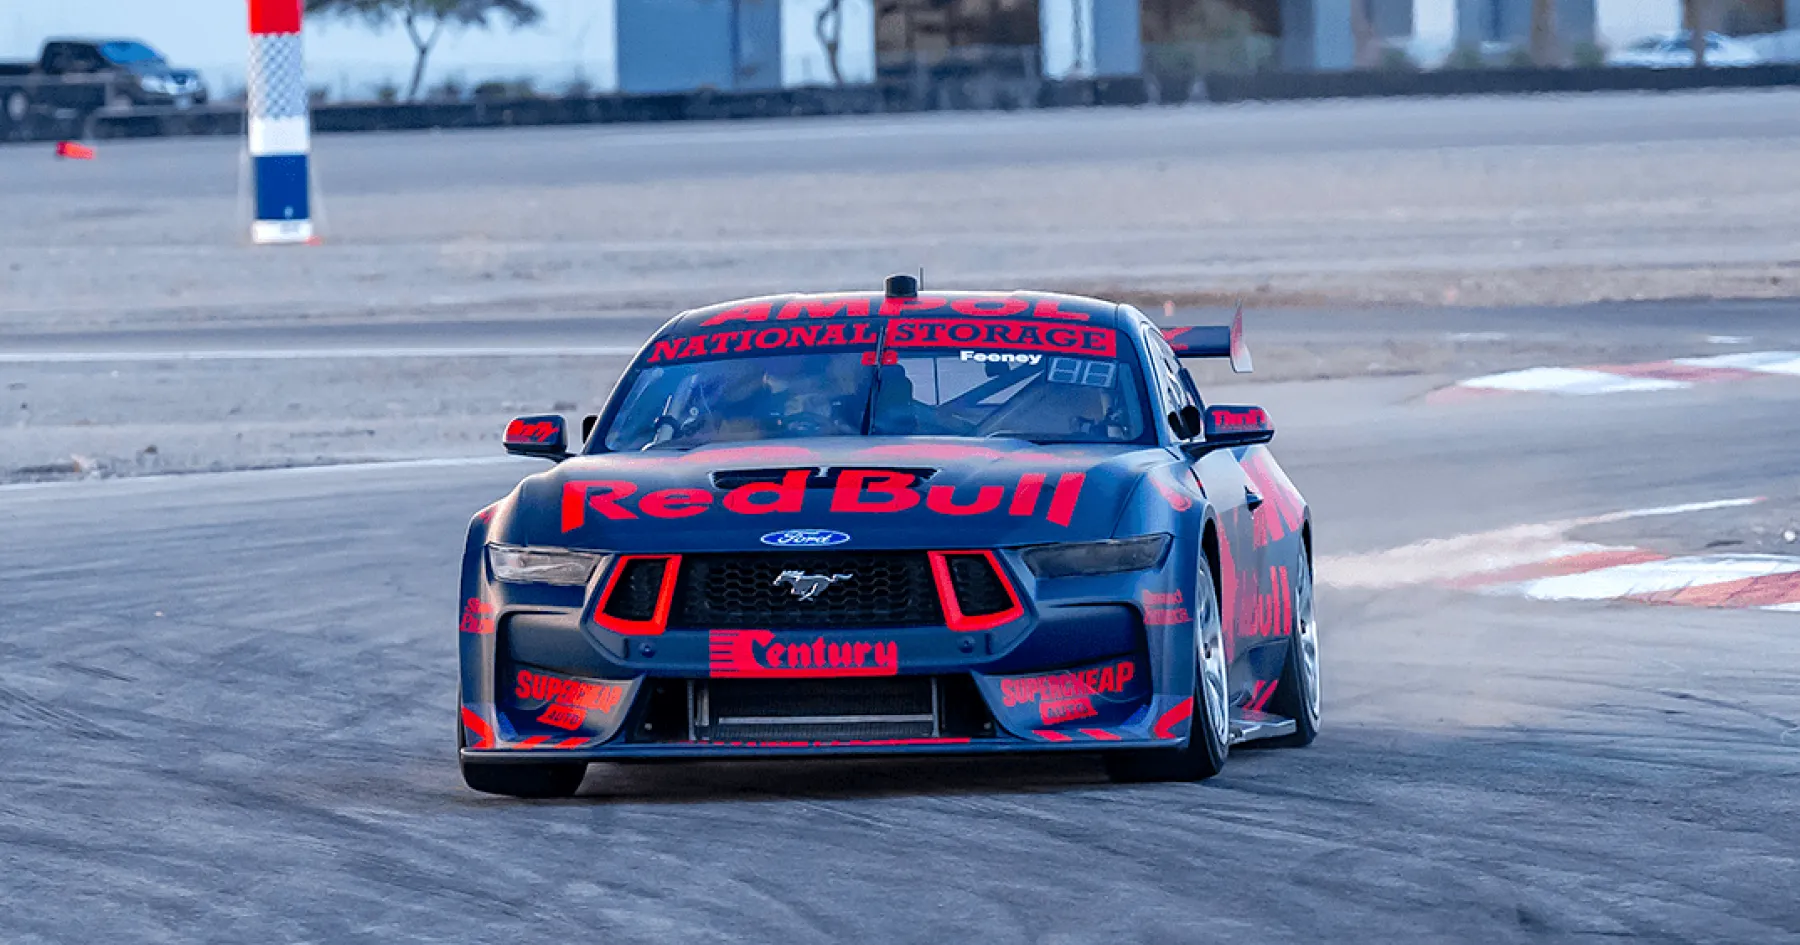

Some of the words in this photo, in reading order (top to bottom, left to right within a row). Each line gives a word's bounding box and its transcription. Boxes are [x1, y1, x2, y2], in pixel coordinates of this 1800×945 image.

[700, 297, 1090, 327] AMPOL
[647, 323, 878, 363] NATIONAL
[893, 322, 1108, 351] STORAGE
[960, 350, 1043, 365] Feeney
[561, 469, 811, 533] Red
[830, 470, 1087, 528] Bull
[776, 530, 833, 545] Ford
[709, 629, 898, 678] Century
[546, 710, 581, 726] AUTO
